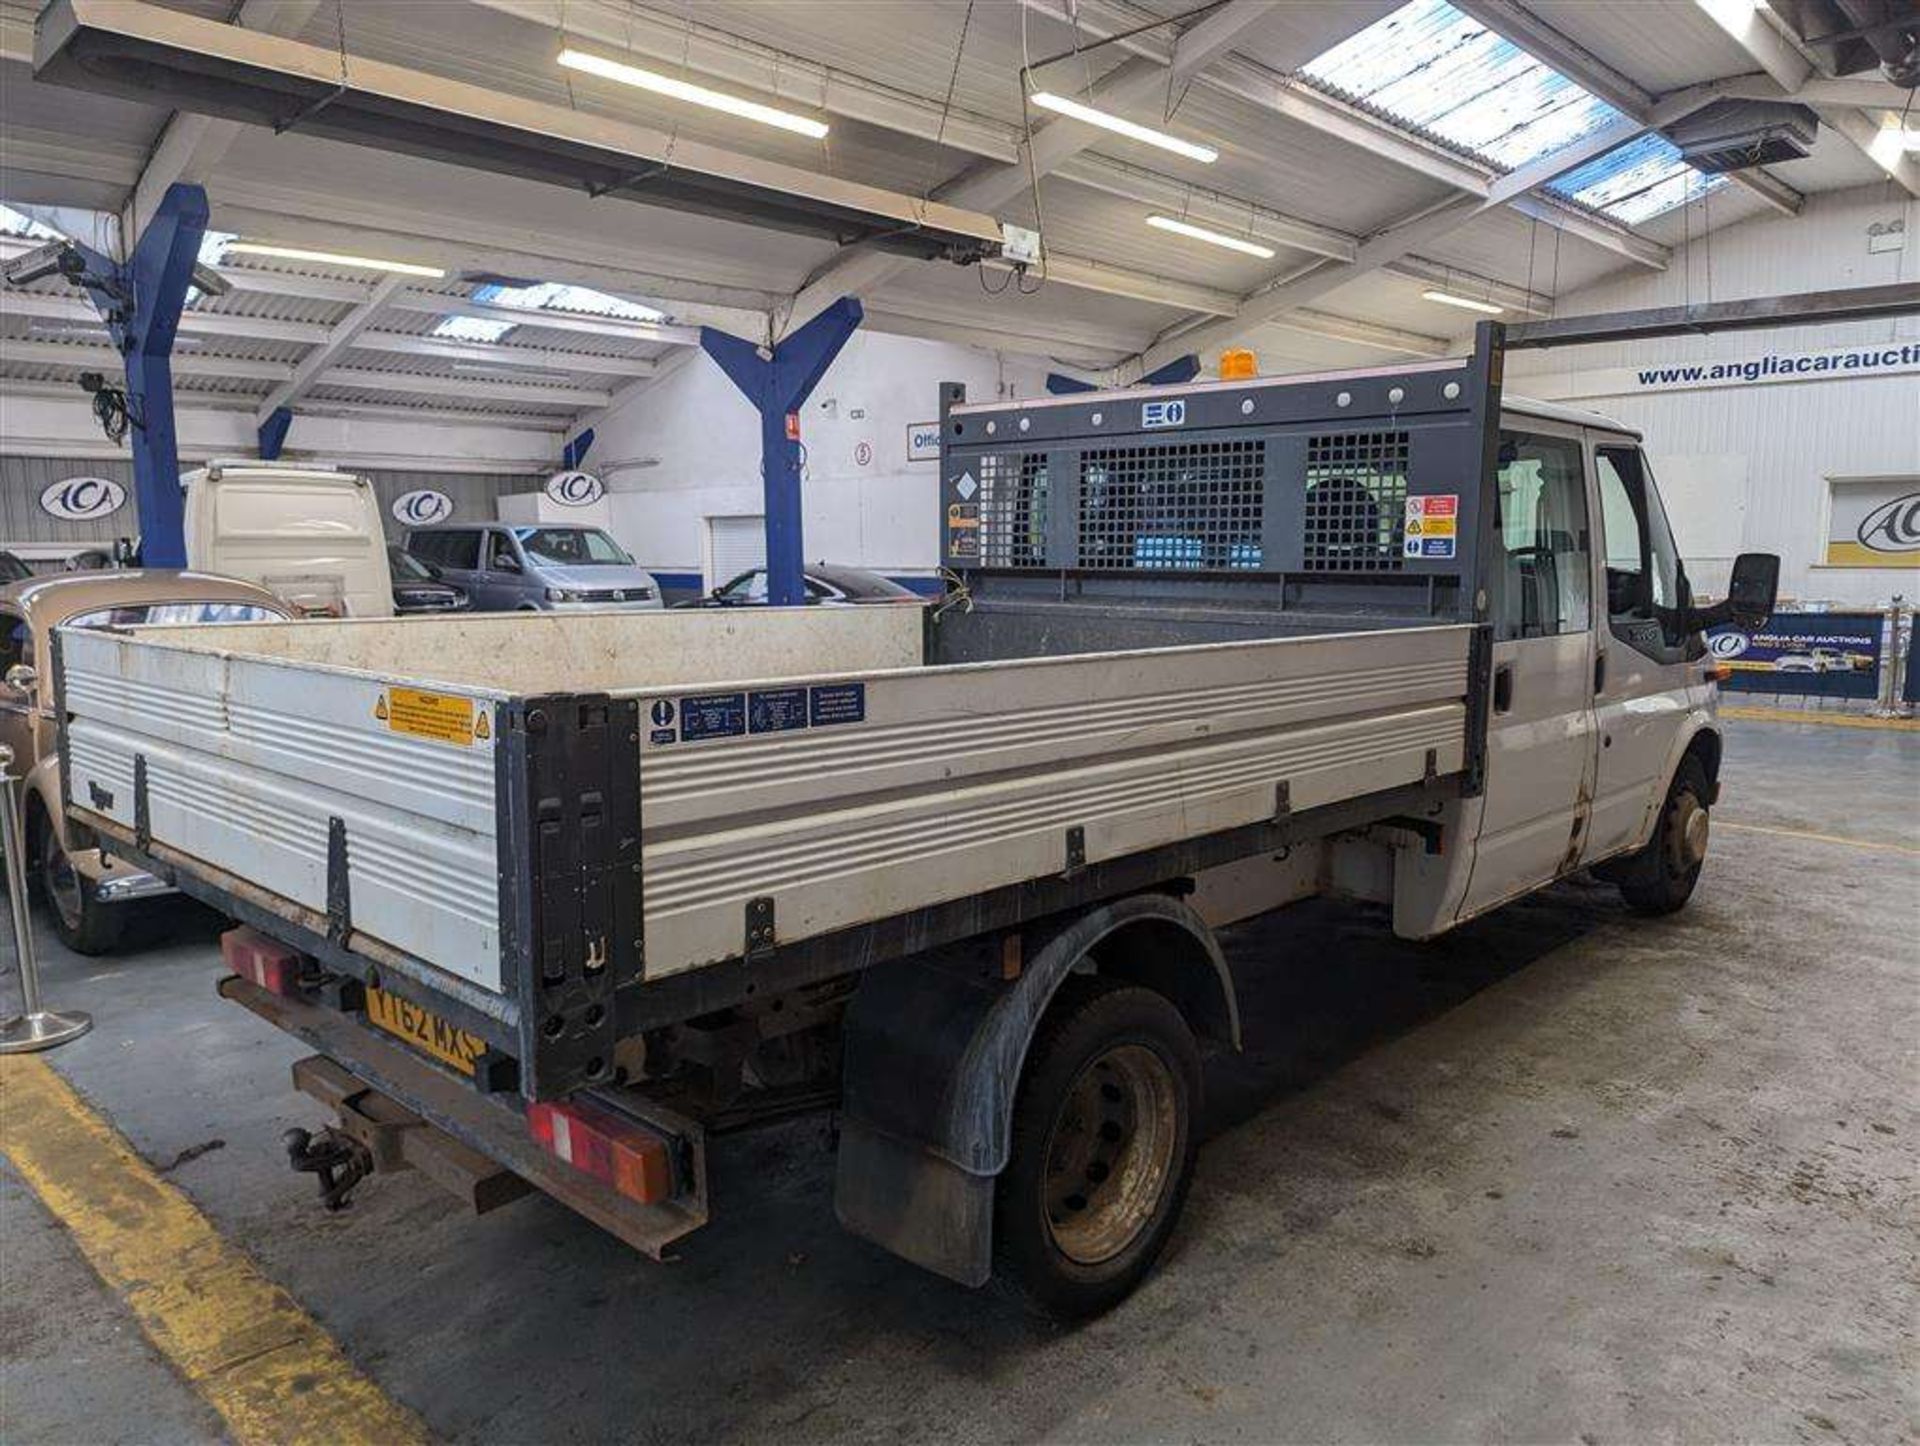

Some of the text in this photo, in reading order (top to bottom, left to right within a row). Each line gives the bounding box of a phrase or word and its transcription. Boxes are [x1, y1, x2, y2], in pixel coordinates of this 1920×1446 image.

[1638, 344, 1920, 384] www.angliacaraucti
[45, 481, 114, 514] ACA
[1752, 633, 1791, 643] ANGLIA
[1816, 635, 1871, 645] AUCTIONS
